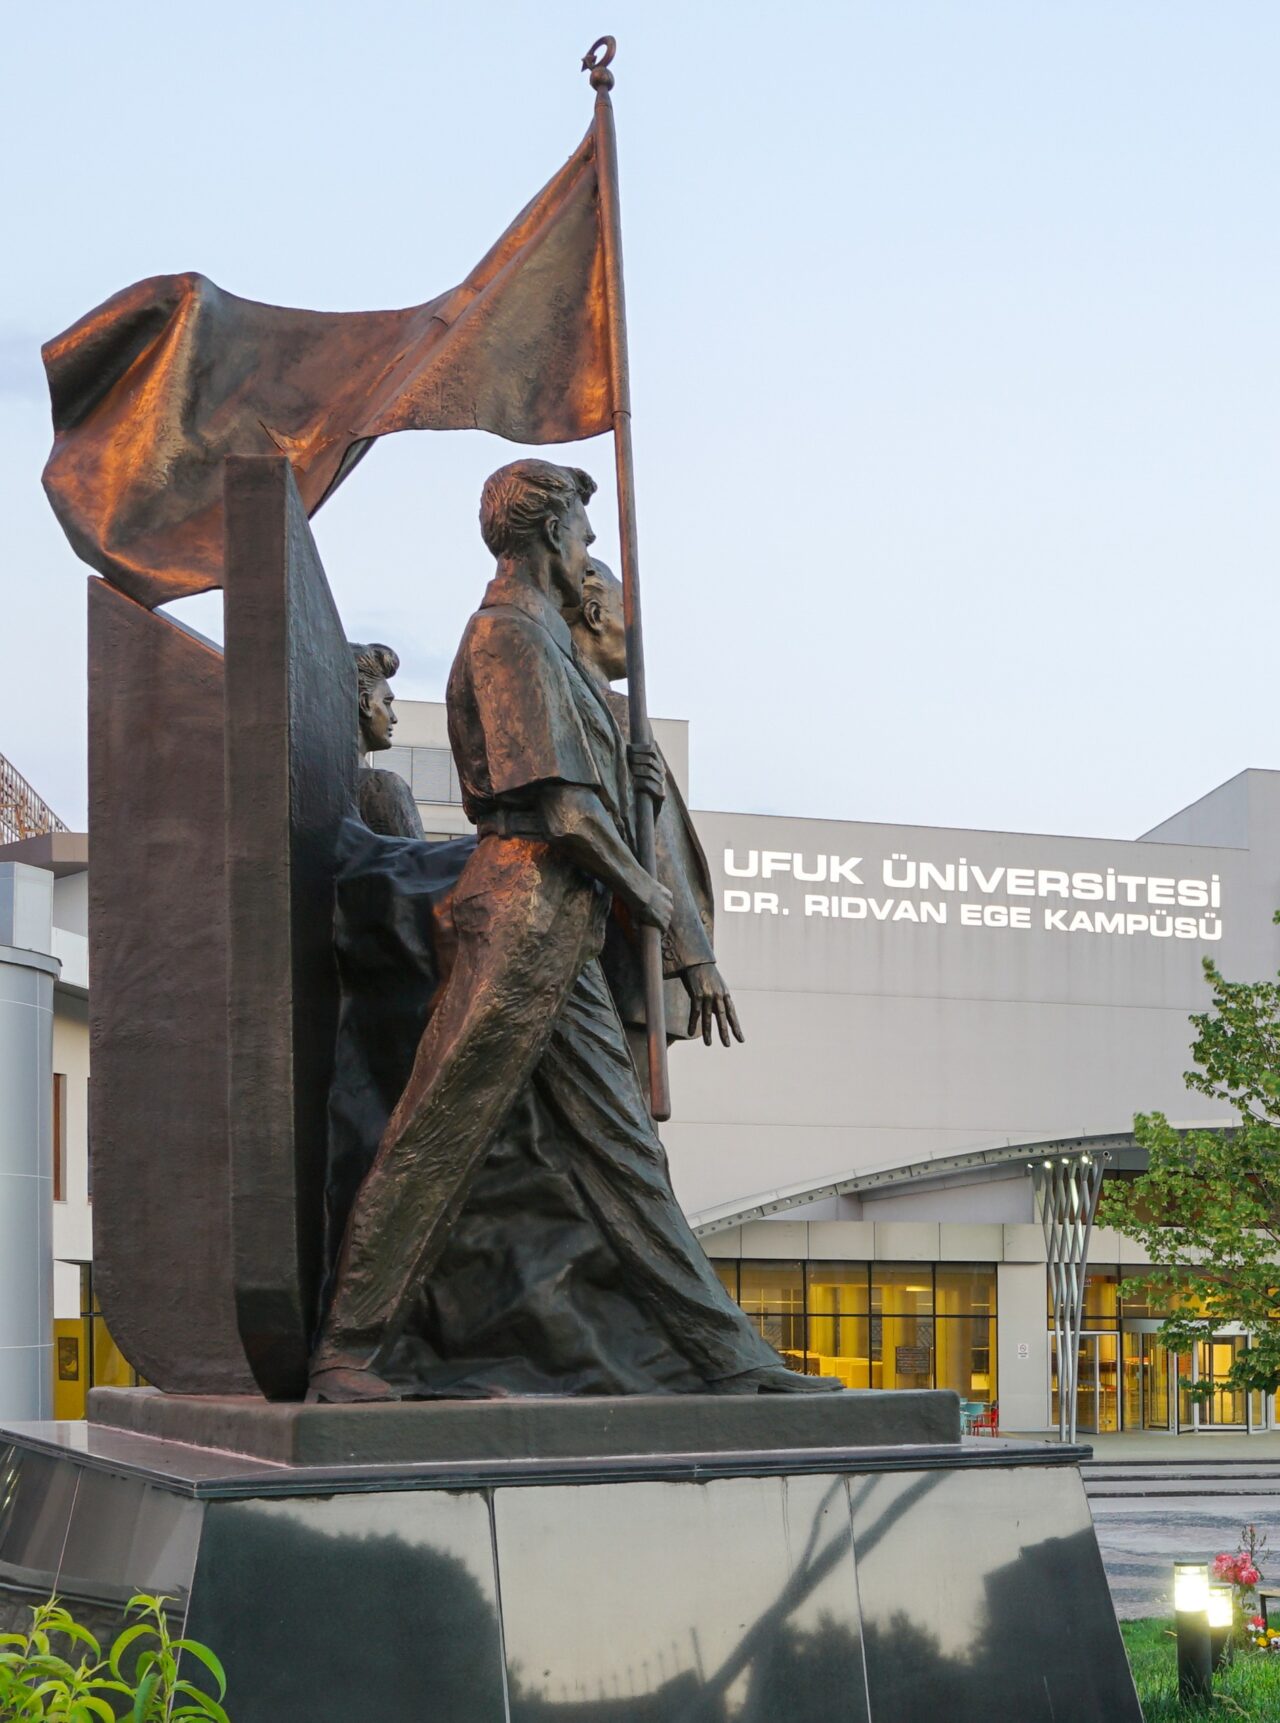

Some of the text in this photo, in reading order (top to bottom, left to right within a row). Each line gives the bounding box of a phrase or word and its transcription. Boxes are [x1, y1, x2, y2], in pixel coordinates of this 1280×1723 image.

[723, 848, 1221, 908] UFUK ÜNİVERSİTESİ
[723, 889, 1223, 941] DR. RIDVAN EGE KAMPÜSÜ
